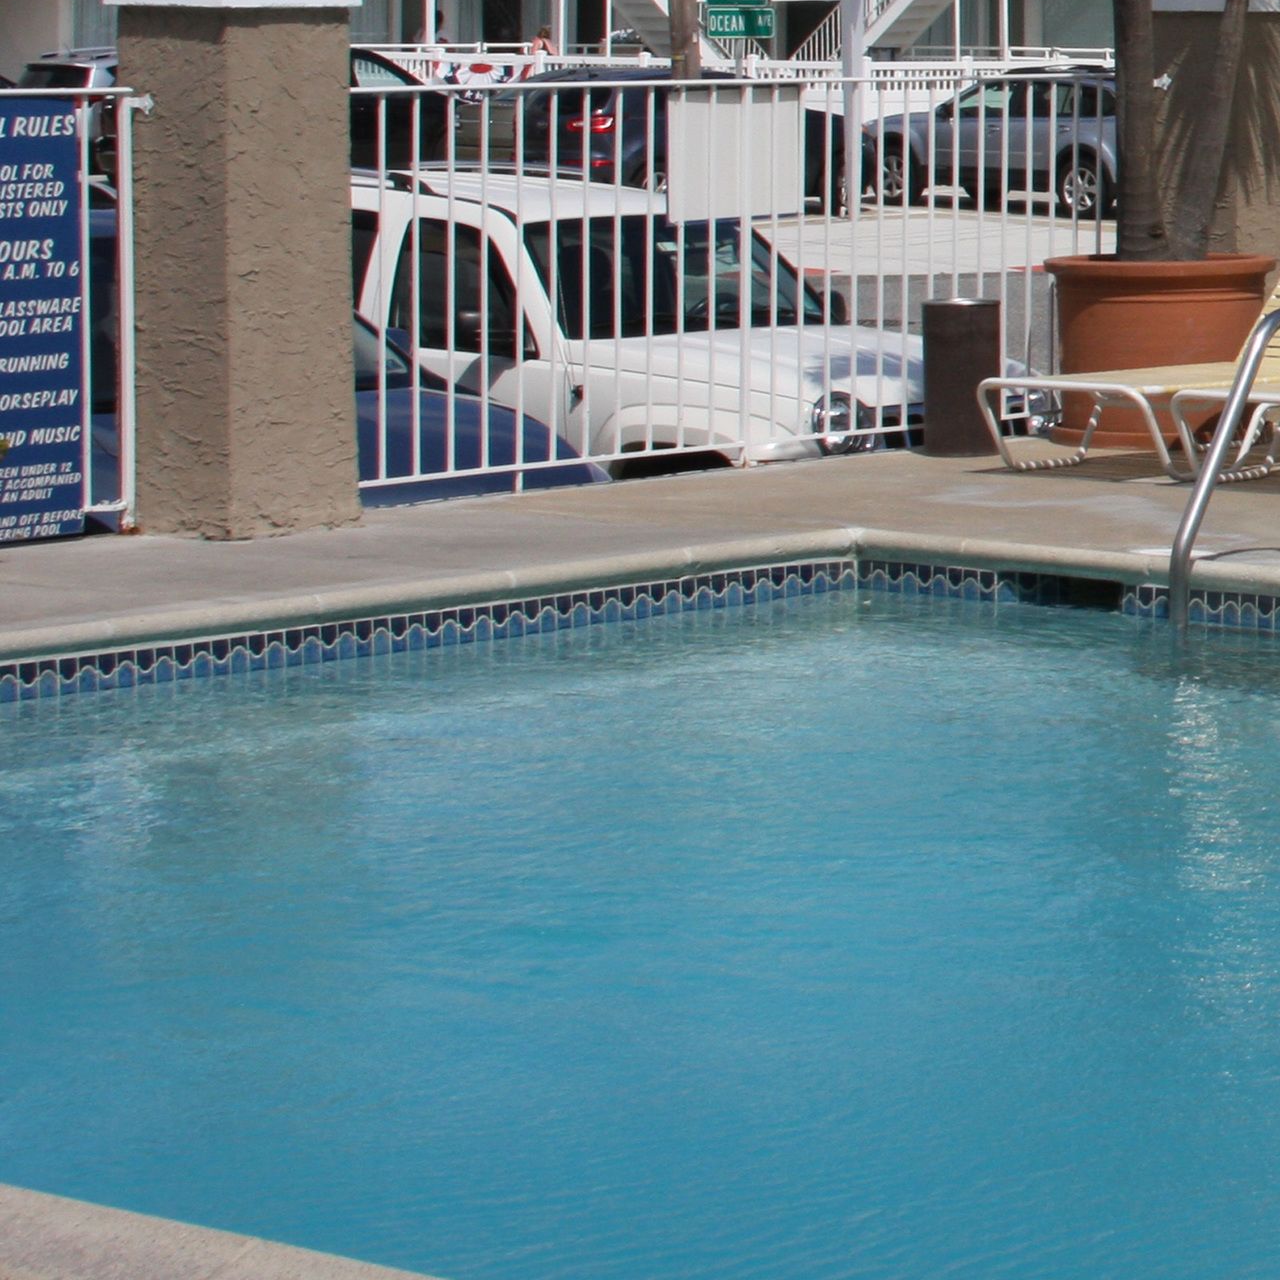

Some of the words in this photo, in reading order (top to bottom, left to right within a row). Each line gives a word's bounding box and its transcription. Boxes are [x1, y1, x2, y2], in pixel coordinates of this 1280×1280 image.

[710, 15, 746, 32] OCEAN
[12, 114, 76, 138] RULES
[22, 163, 55, 180] FOR
[28, 200, 69, 218] ONLY
[3, 262, 40, 280] A.M.
[46, 260, 66, 278] TO
[69, 260, 80, 277] 6
[29, 315, 73, 334] AREA
[30, 425, 81, 445] MUSIC
[21, 463, 57, 477] UNDER
[60, 461, 73, 473] 12
[5, 472, 82, 490] ACCOMPANIED
[2, 491, 19, 503] AN
[19, 487, 54, 501] ADULT
[19, 512, 41, 526] OFF
[33, 523, 61, 538] POOL
